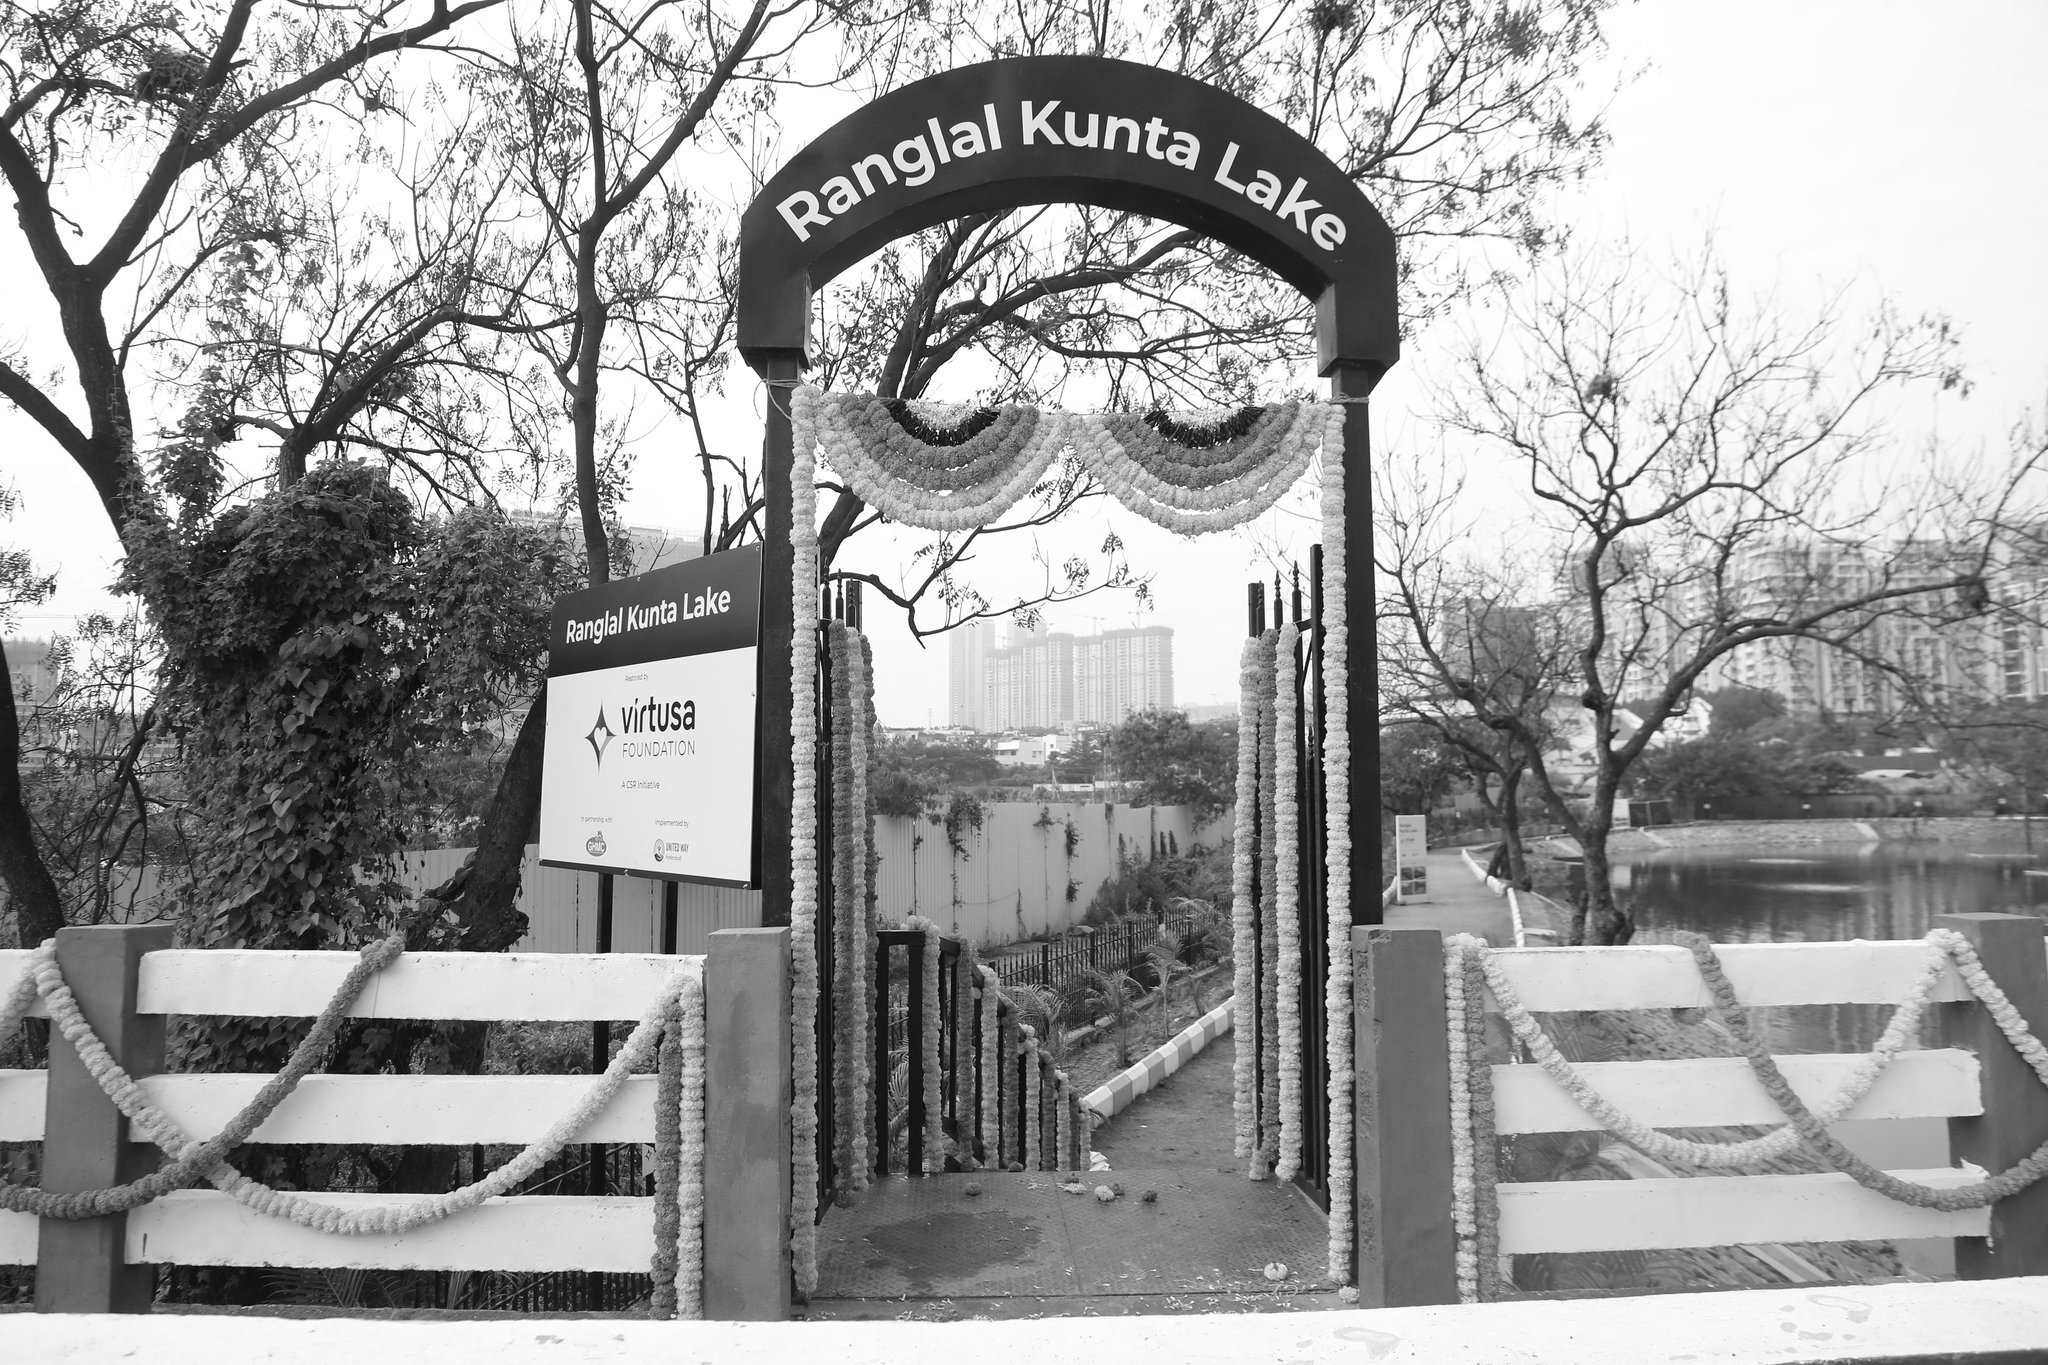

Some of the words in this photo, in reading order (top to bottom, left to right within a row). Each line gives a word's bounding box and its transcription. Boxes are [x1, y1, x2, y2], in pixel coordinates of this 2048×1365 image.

[775, 103, 1003, 243] Ranglal
[1021, 99, 1200, 171] Kunta
[1213, 141, 1348, 252] Lake
[566, 606, 623, 644] Ranglal
[627, 599, 677, 632] Kunta
[683, 586, 731, 621] Lake
[625, 674, 643, 682] Restored
[622, 740, 696, 758] FOUNDATION
[626, 780, 637, 789] CSR
[638, 780, 661, 789] Initiative
[666, 843, 680, 852] UNITED
[681, 844, 689, 852] WAY
